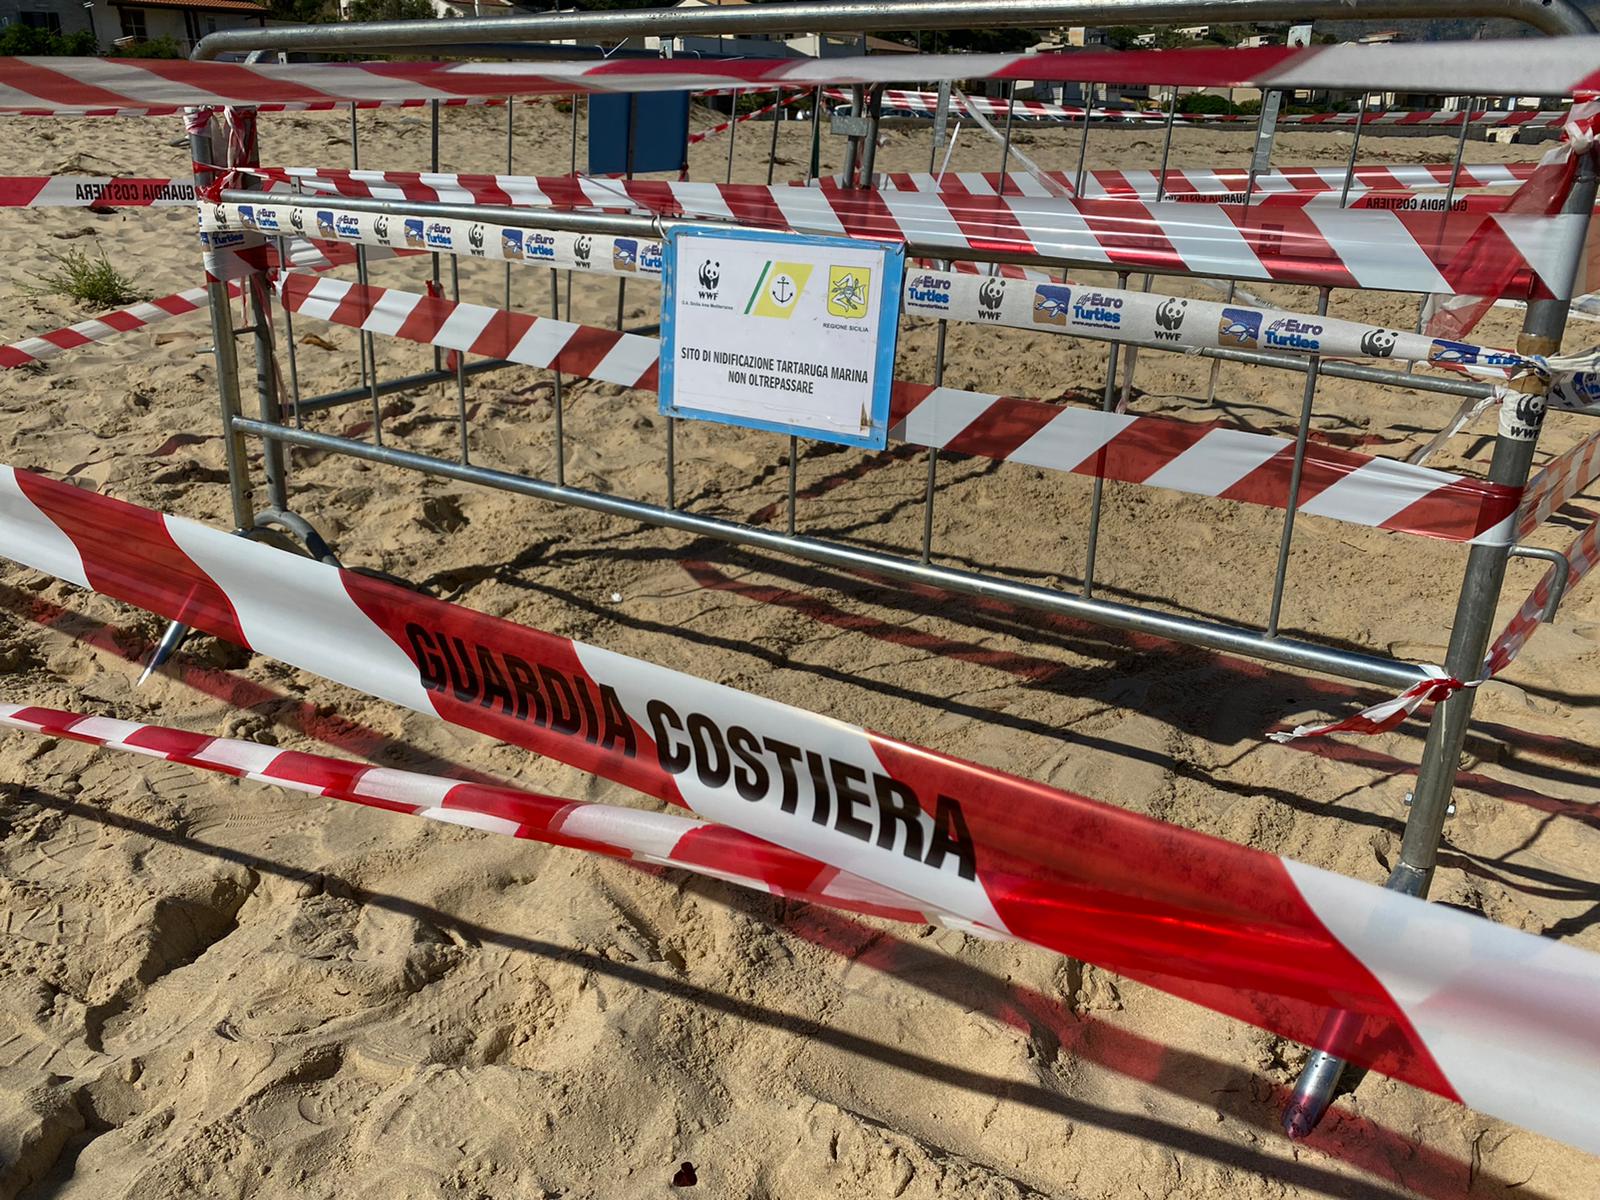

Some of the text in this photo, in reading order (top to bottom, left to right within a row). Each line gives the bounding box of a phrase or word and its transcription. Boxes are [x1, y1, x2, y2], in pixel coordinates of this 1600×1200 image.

[575, 260, 591, 269] WWF
[698, 291, 719, 301] WWF
[978, 310, 1002, 320] WWF
[822, 322, 869, 333] REGIONE SICILIA
[1154, 330, 1182, 341] WWF
[681, 347, 868, 384] SITO DI NIDIFICAZIONE TARTARUGA MARINA
[728, 370, 814, 394] NON OLTREPASSARE
[404, 622, 977, 881] GUARDIA COSTIERA
